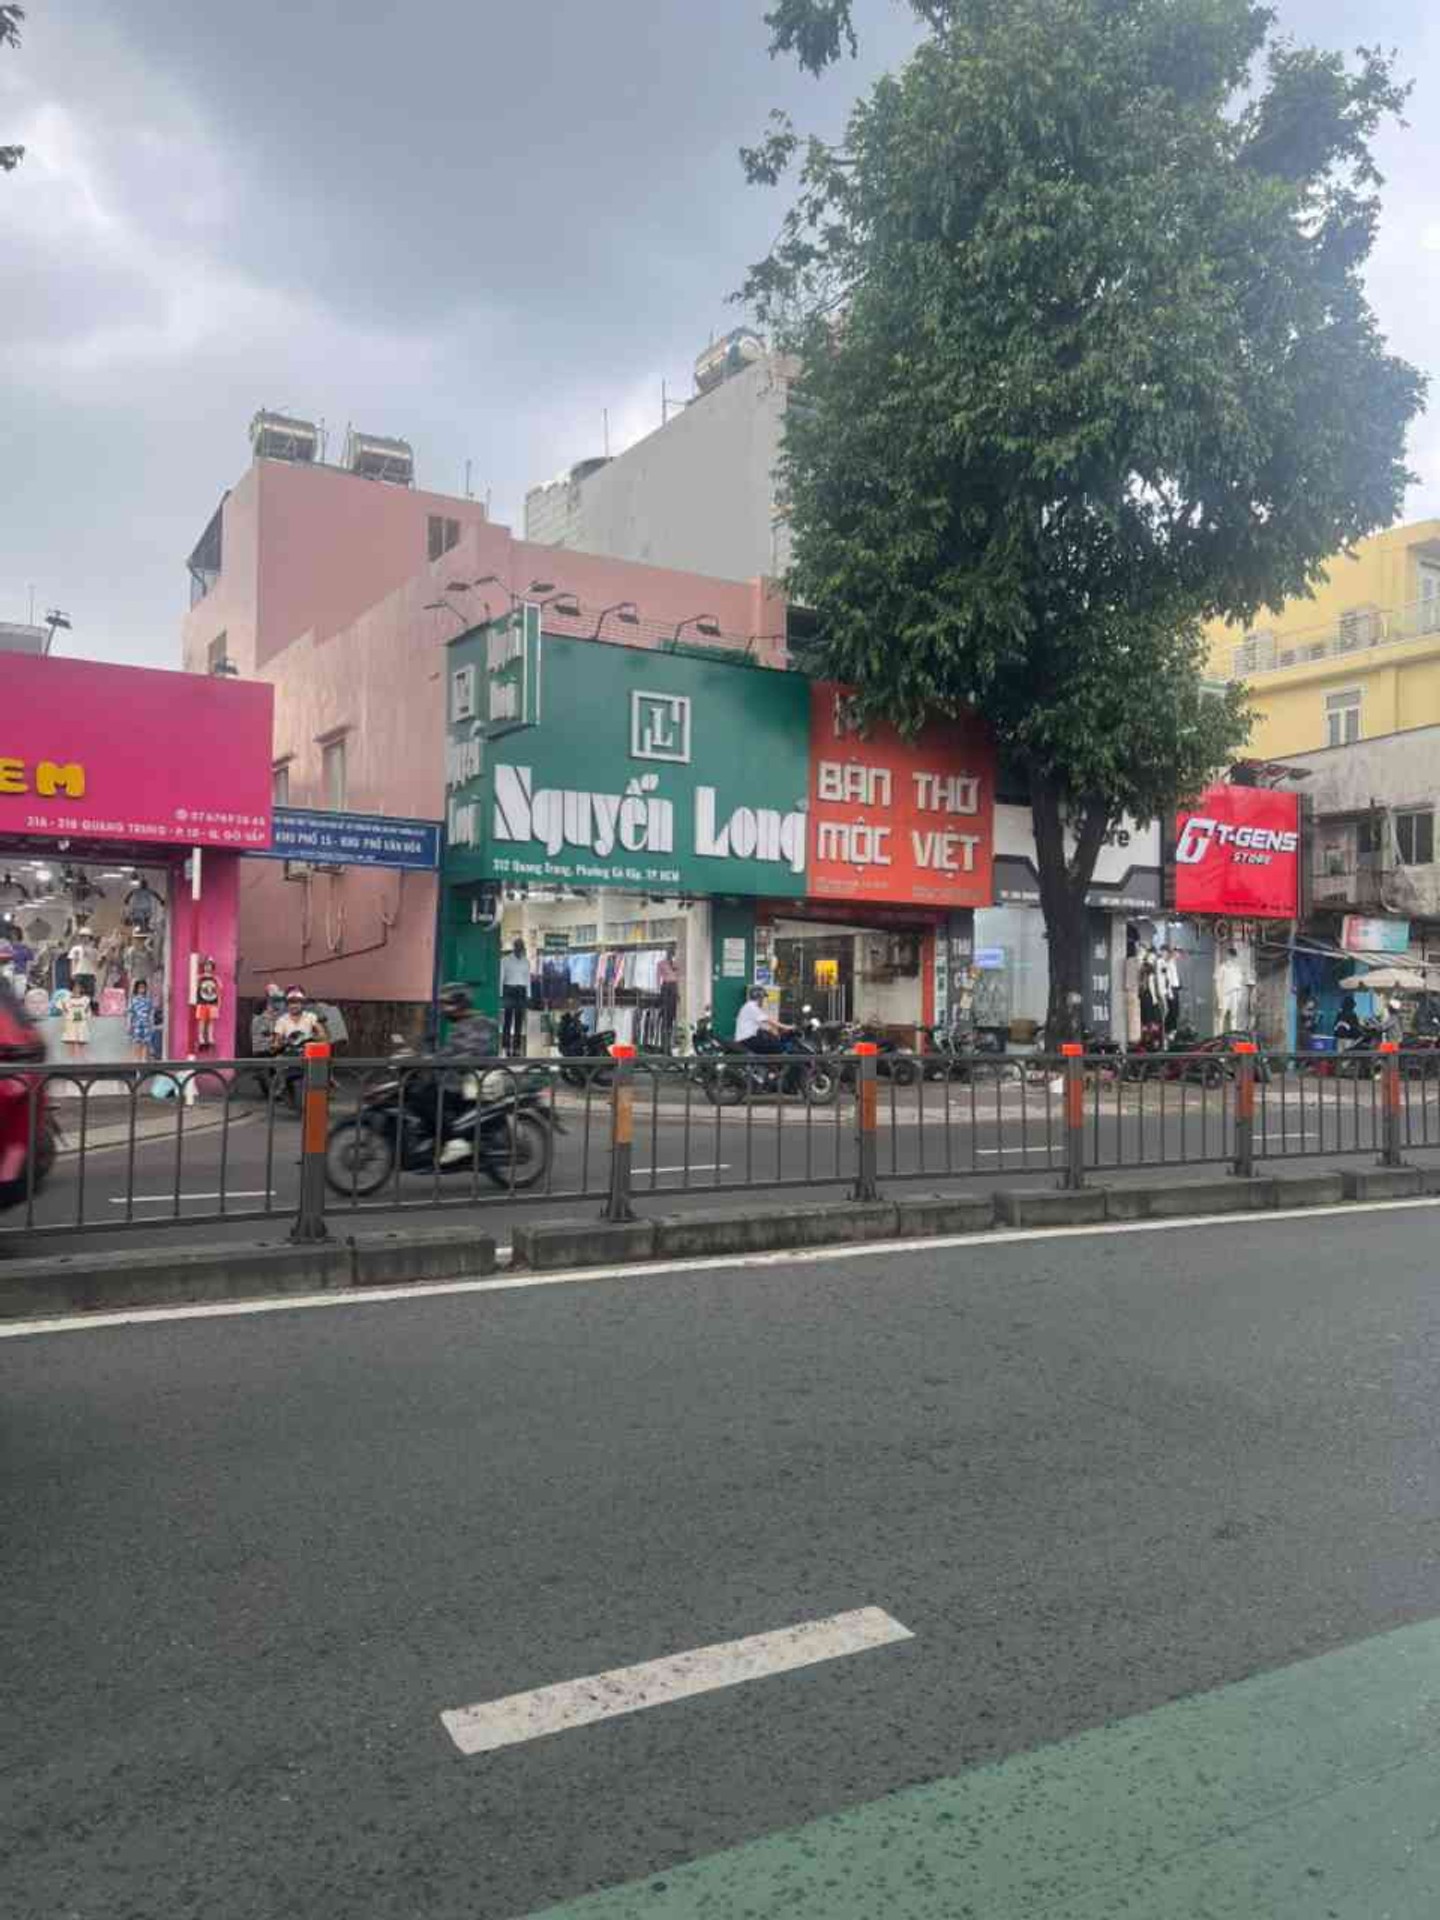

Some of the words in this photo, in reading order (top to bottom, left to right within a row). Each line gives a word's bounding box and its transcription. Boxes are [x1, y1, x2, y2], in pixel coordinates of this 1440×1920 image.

[0, 757, 86, 799] EM
[817, 756, 893, 807] BÀN
[275, 831, 295, 844] KHU
[298, 829, 318, 846] PHỐ
[340, 836, 359, 849] KHU
[362, 836, 383, 850] PHỐ
[694, 785, 807, 874] Long
[817, 815, 893, 872] MỘC
[911, 825, 981, 880] VIỆT
